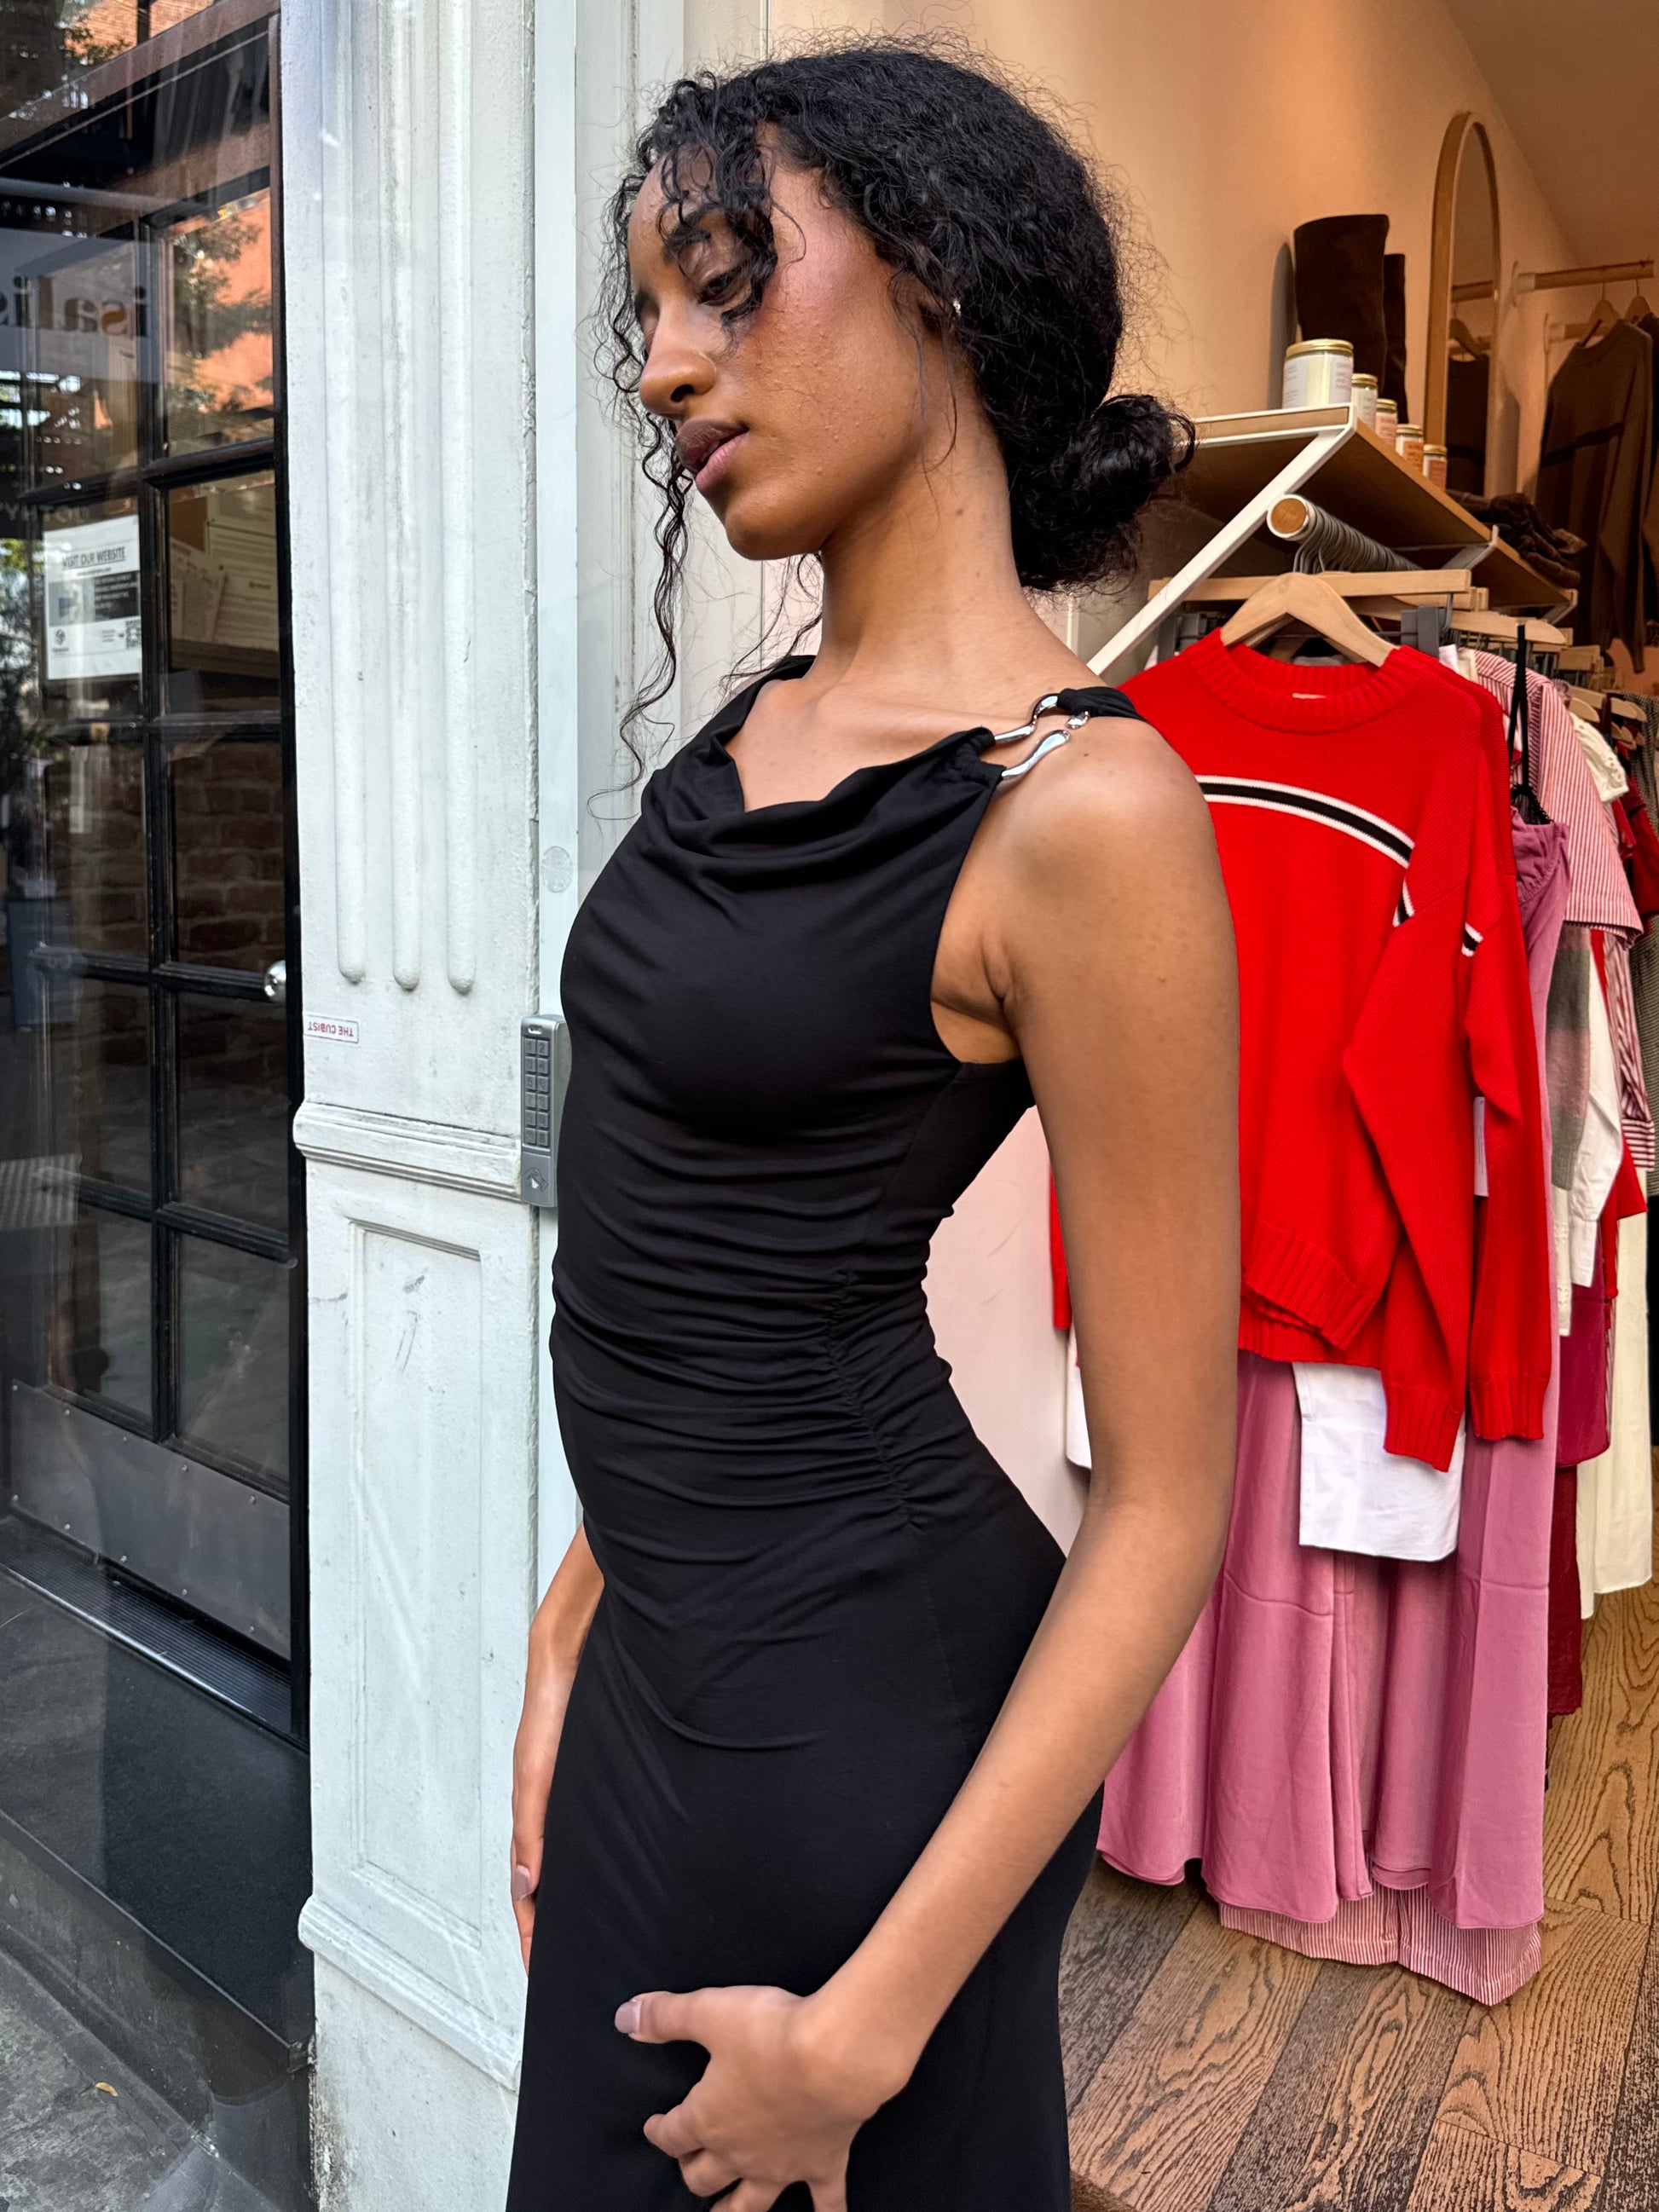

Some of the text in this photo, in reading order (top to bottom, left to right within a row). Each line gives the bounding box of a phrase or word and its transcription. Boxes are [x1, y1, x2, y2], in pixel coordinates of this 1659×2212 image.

[97, 546, 126, 562] WEBSITE
[308, 1021, 355, 1037] THE CUBIST
